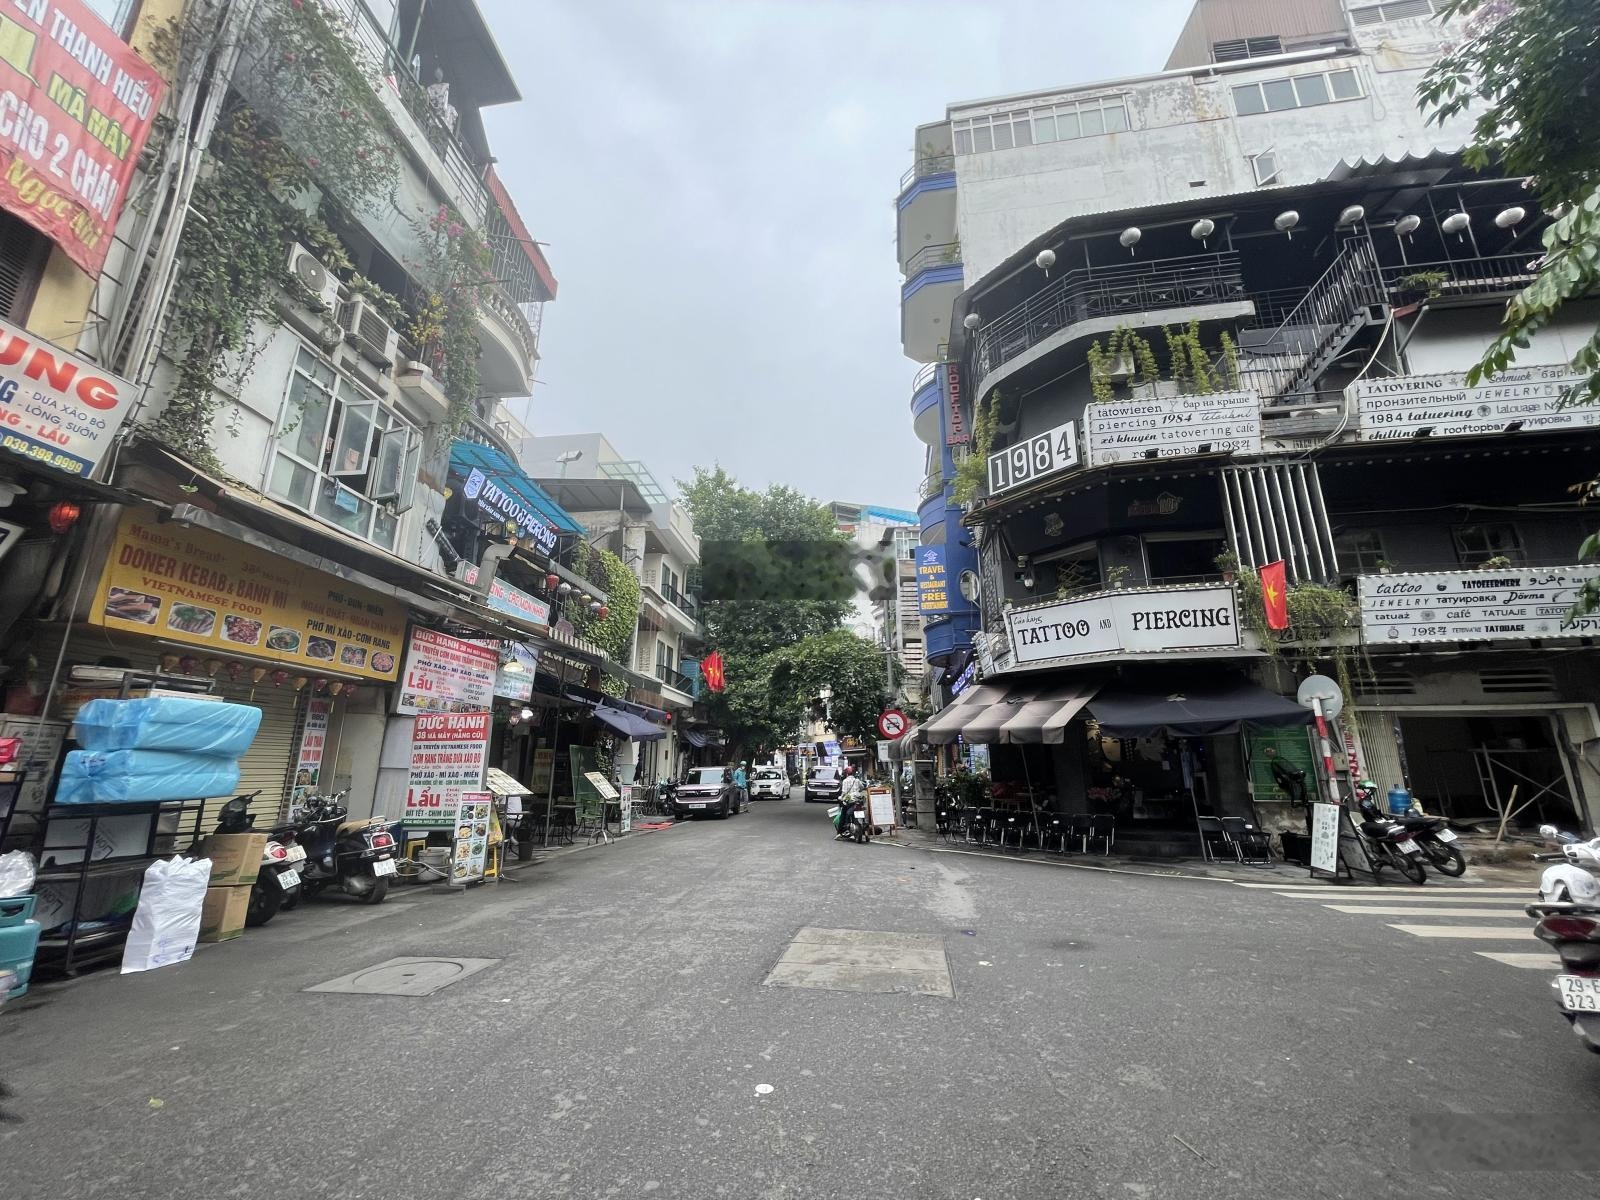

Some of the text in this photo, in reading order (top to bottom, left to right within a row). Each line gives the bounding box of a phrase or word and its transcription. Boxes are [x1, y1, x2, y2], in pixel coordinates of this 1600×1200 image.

[50, 8, 113, 86] THANH
[0, 91, 48, 160] CHO
[50, 133, 69, 178] 2
[1367, 380, 1443, 394] TATOVERING
[1475, 386, 1540, 400] JEWELRY
[1183, 401, 1199, 410] бар
[1217, 396, 1250, 407] крыше
[1366, 391, 1467, 409] пронзительный
[1098, 404, 1162, 418] tätowieren
[1369, 413, 1403, 424] 1984
[1407, 408, 1473, 421] tatuering
[1099, 419, 1156, 431] piercing
[1162, 413, 1193, 424] 1984
[1444, 423, 1505, 434] rooftopbar
[946, 434, 970, 446] BAR
[1161, 425, 1231, 440] tatovering
[995, 430, 1072, 487] 1984
[119, 543, 177, 578] DONER
[180, 561, 227, 592] KEBAB
[226, 583, 234, 595] &
[919, 565, 945, 575] TRAVEL
[1376, 582, 1422, 594] tattoo
[142, 577, 263, 617] VIETNAMESE FOOD
[922, 592, 947, 602] FREE
[1371, 598, 1430, 607] JEWELRY
[1436, 594, 1497, 605] татуировка
[1482, 608, 1527, 617] TATUAJE
[1018, 607, 1231, 645] TATTOO AND PIERCING
[372, 635, 391, 649] RANG
[416, 629, 434, 642] ĐỨC
[436, 636, 459, 650] HẠNH
[408, 672, 433, 691] Lẩu
[418, 715, 485, 731] ĐỨC HẠNH
[407, 786, 440, 808] Lẩu
